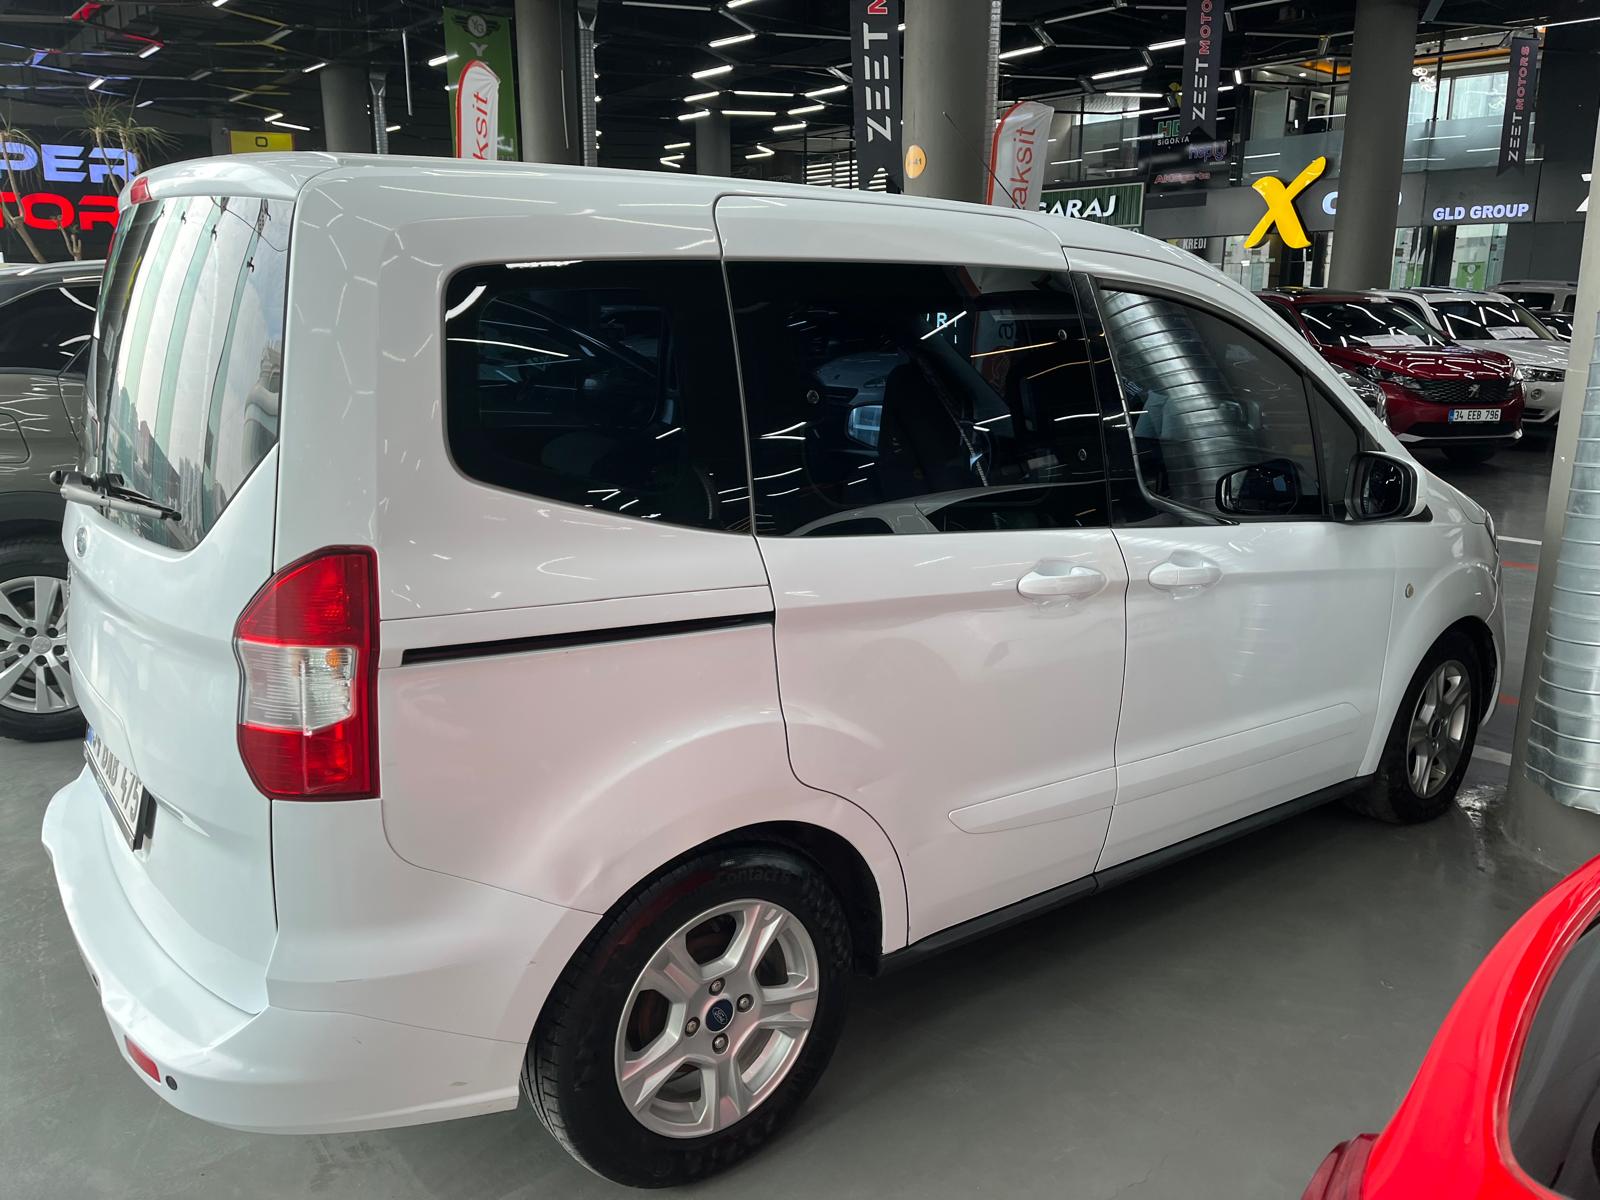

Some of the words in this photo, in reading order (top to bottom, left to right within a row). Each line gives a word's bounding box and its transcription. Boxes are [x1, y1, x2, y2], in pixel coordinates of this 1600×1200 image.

[1199, 0, 1213, 55] MOTO
[863, 22, 892, 142] ZEET
[1192, 58, 1209, 120] ZEET
[1508, 112, 1522, 162] ZEET
[1515, 46, 1530, 111] MOTORS
[473, 92, 488, 160] ksit
[1009, 126, 1036, 209] aksit
[1432, 206, 1466, 221] GLD
[1470, 203, 1529, 219] GROUP
[1454, 410, 1463, 420] 34
[1467, 410, 1481, 420] EEB
[1485, 410, 1499, 420] 796
